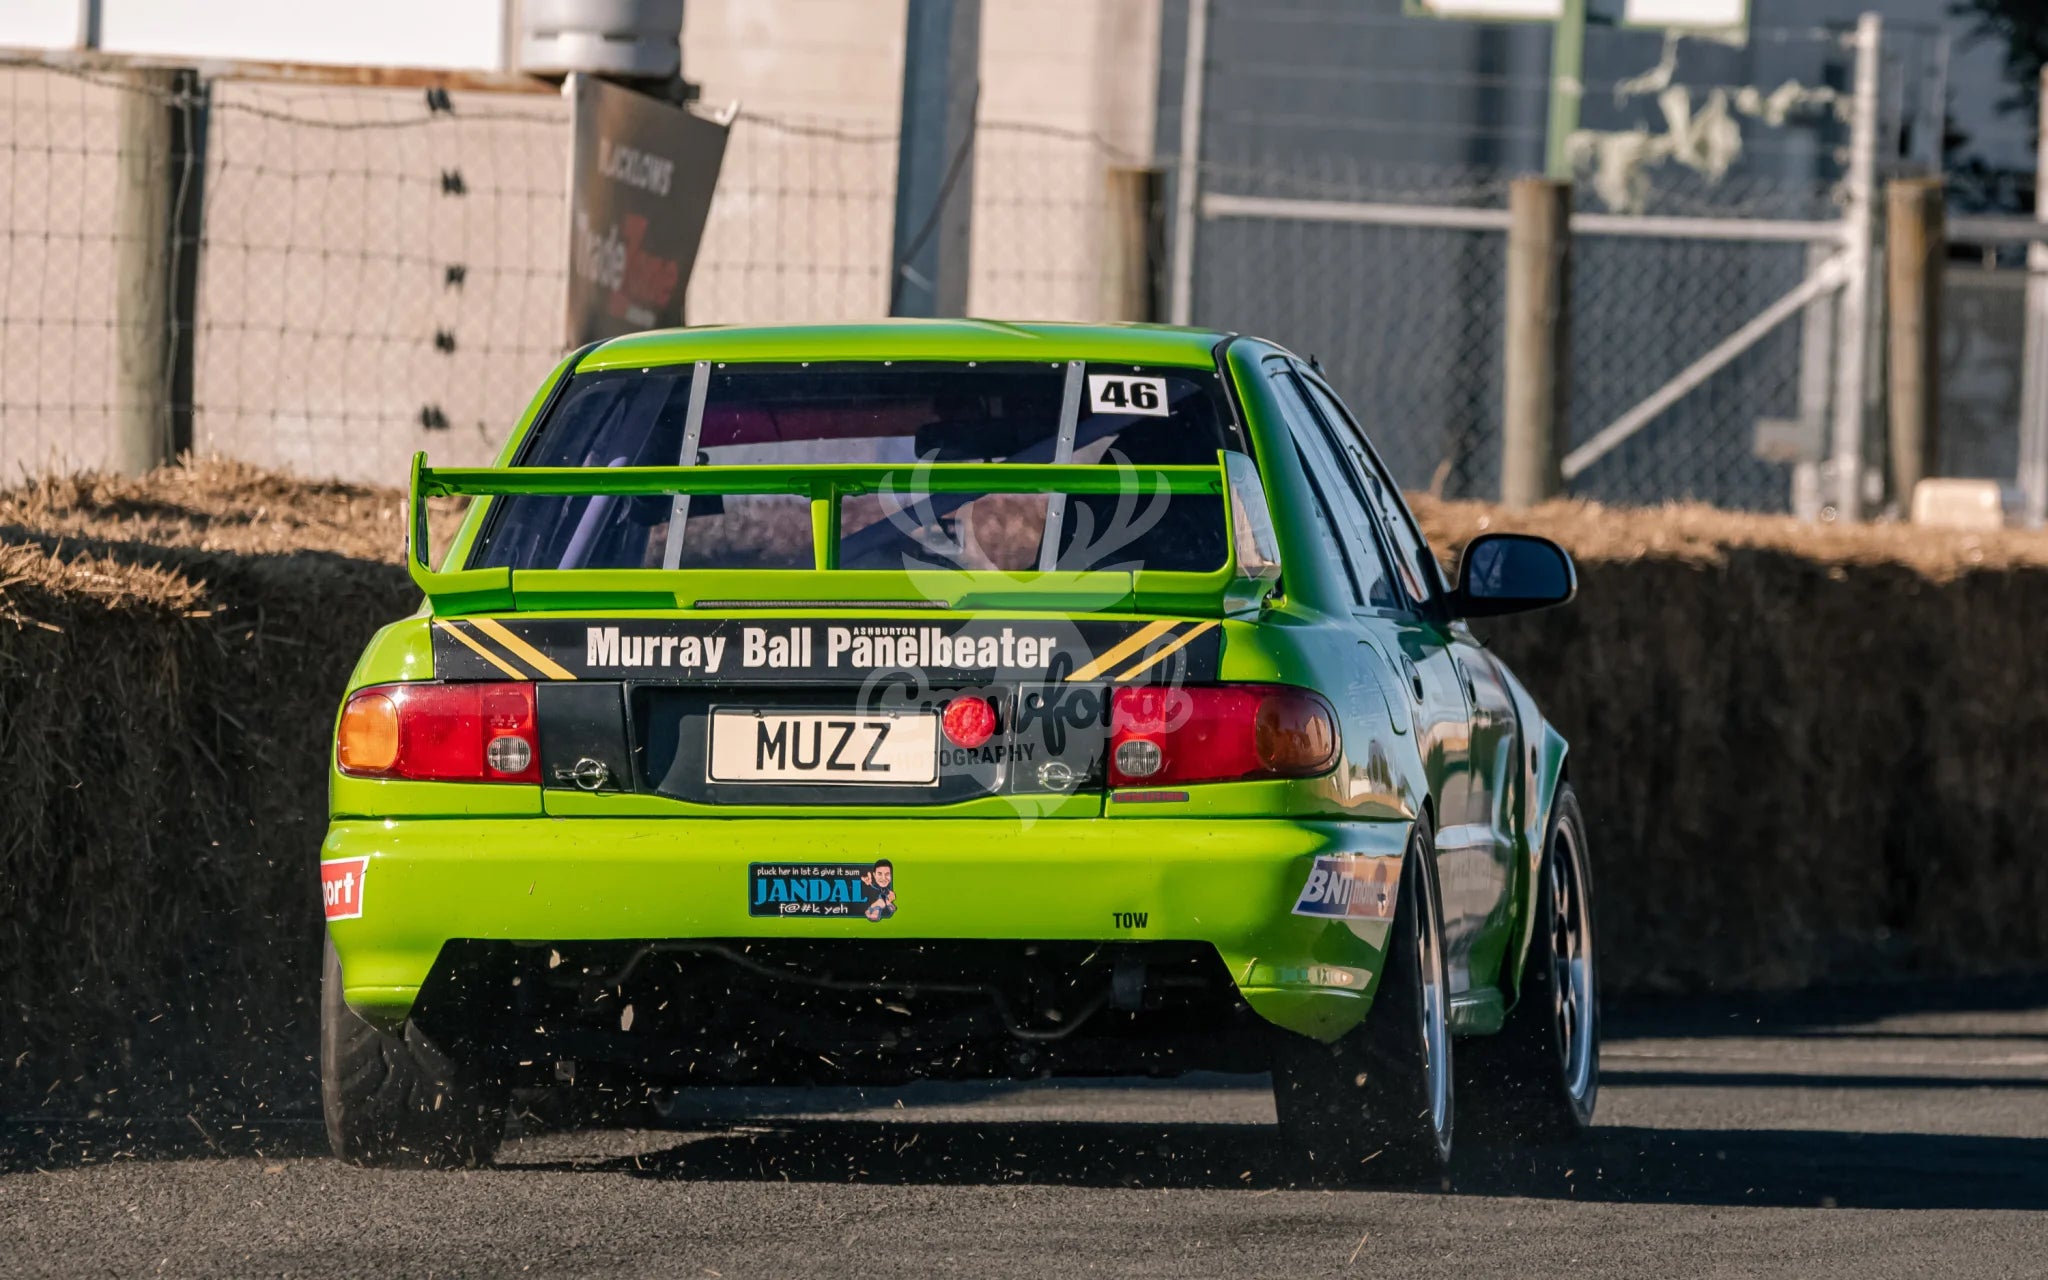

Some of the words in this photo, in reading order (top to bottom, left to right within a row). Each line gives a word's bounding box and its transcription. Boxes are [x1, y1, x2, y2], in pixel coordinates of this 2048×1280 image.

[1100, 381, 1159, 410] 46
[853, 627, 916, 636] ASHBURTON
[587, 627, 727, 673] Murray
[743, 627, 811, 668] Ball
[828, 627, 1057, 668] Panelbeater
[756, 720, 891, 772] MUZZ
[757, 867, 777, 876] pluck
[778, 867, 791, 876] her
[792, 867, 799, 875] in
[820, 867, 835, 877] give
[836, 867, 843, 876] it
[754, 878, 868, 906] JANDAL
[1299, 868, 1355, 905] BNT
[779, 903, 820, 915] f@#k
[824, 903, 848, 915] yeh
[1112, 912, 1148, 929] TOW
